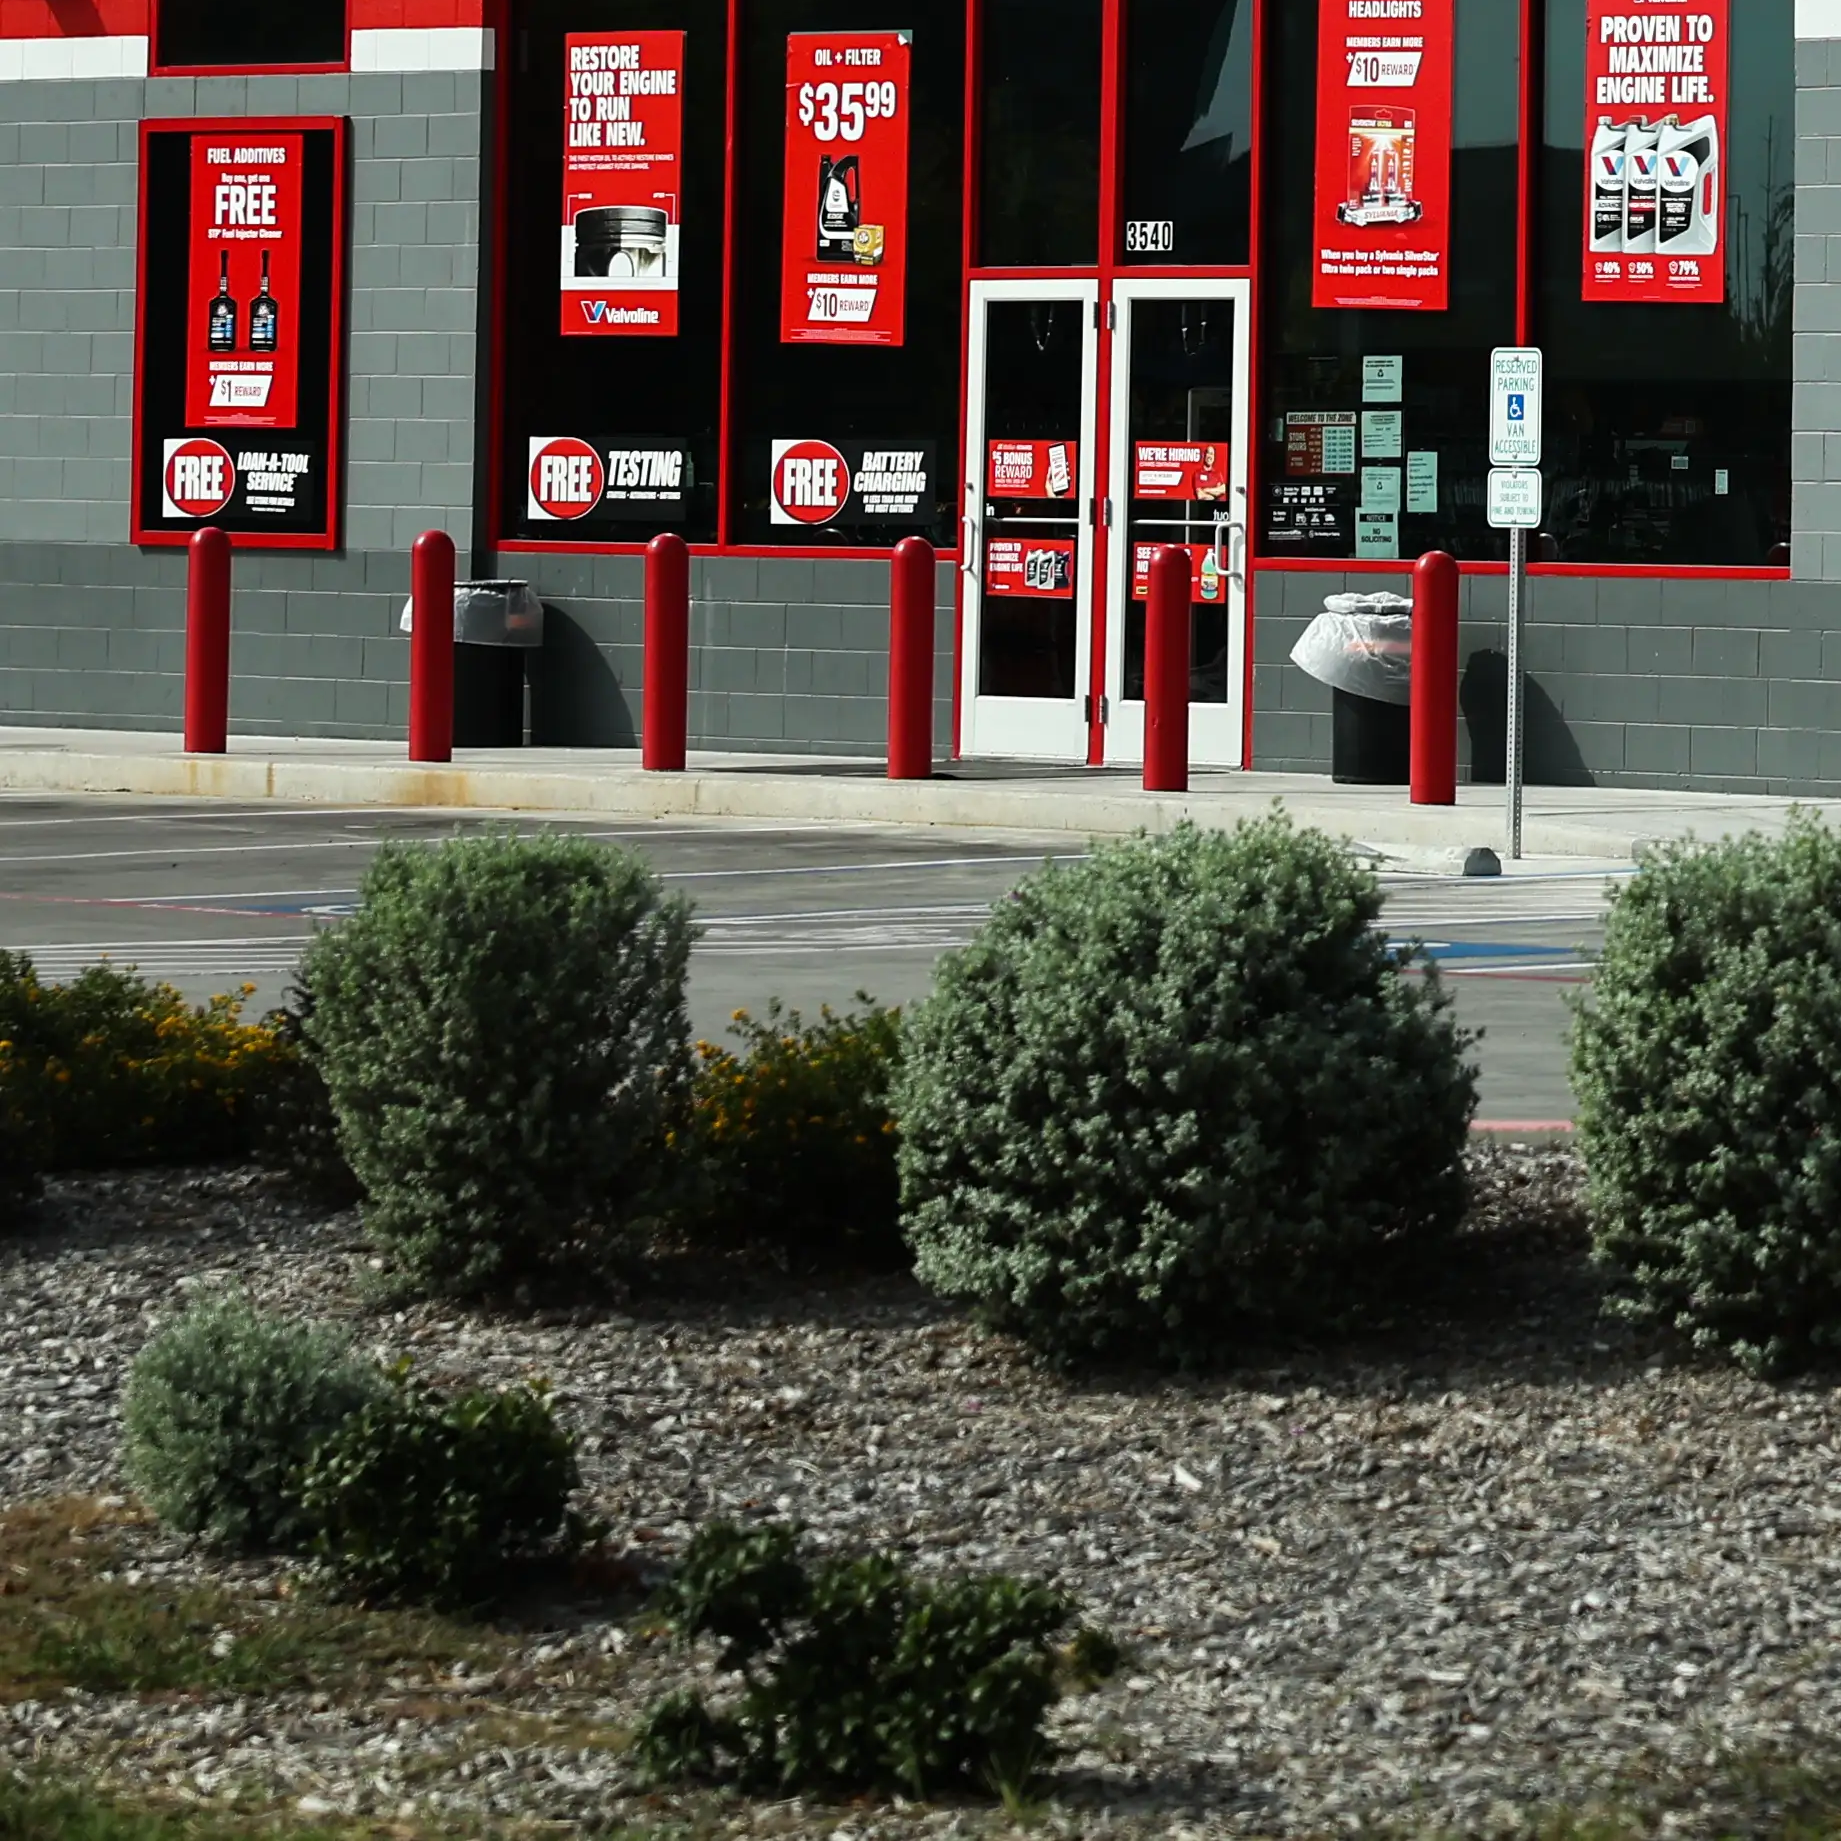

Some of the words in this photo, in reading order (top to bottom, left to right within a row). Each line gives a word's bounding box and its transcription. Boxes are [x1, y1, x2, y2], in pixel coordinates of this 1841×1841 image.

[1348, 0, 1422, 18] HEADLIGHTS
[1601, 15, 1680, 43] PROVEN
[1686, 15, 1713, 42] TO
[1346, 37, 1381, 48] MEMBERS
[1382, 37, 1401, 48] EARN
[1402, 37, 1423, 48] MORE
[571, 45, 639, 71] RESTORE
[815, 49, 832, 66] OIL
[845, 48, 881, 65] FILTER
[1609, 45, 1704, 73] MAXIMIZE
[1356, 57, 1379, 82] $10
[1381, 64, 1414, 76] REWARD
[570, 71, 615, 96] YOUR
[620, 70, 676, 95] ENGINE
[1596, 76, 1665, 104] ENGINE
[1671, 76, 1715, 103] LIFE.
[569, 97, 591, 121] TO
[596, 96, 630, 121] RUN
[569, 122, 601, 146] LIKE
[606, 122, 645, 146] NEW.
[207, 148, 231, 164] FUEL
[233, 147, 285, 163] ADDITIVES
[215, 185, 276, 225] FREE
[1128, 222, 1171, 250] 3540
[807, 273, 839, 283] MEMBERS
[840, 274, 857, 284] EARN
[859, 274, 878, 285] MORE
[605, 307, 659, 323] Valvoline
[816, 293, 837, 317] $10
[840, 300, 869, 311] REWARD
[1496, 360, 1537, 374] RESERVED
[221, 379, 232, 402] $1
[234, 386, 261, 396] REWARD
[1498, 377, 1534, 391] PARKING
[1288, 414, 1316, 423] WELCOME
[1507, 423, 1524, 437] VAN
[1138, 447, 1167, 461] WE'RE
[1169, 448, 1201, 462] HIRING
[1495, 440, 1536, 454] ACCESSIBLE
[237, 452, 309, 473] LOAN-A-TOOL
[608, 450, 682, 487] TESTING
[862, 451, 924, 471] BATTERY
[1003, 452, 1032, 465] BONUS
[174, 456, 224, 500] FREE
[247, 472, 295, 491] SERVICE
[540, 456, 592, 502] FREE
[854, 471, 926, 492] CHARGING
[995, 465, 1032, 479] REWARD
[784, 459, 838, 506] FREE
[986, 503, 995, 516] in
[1137, 547, 1151, 559] SEE
